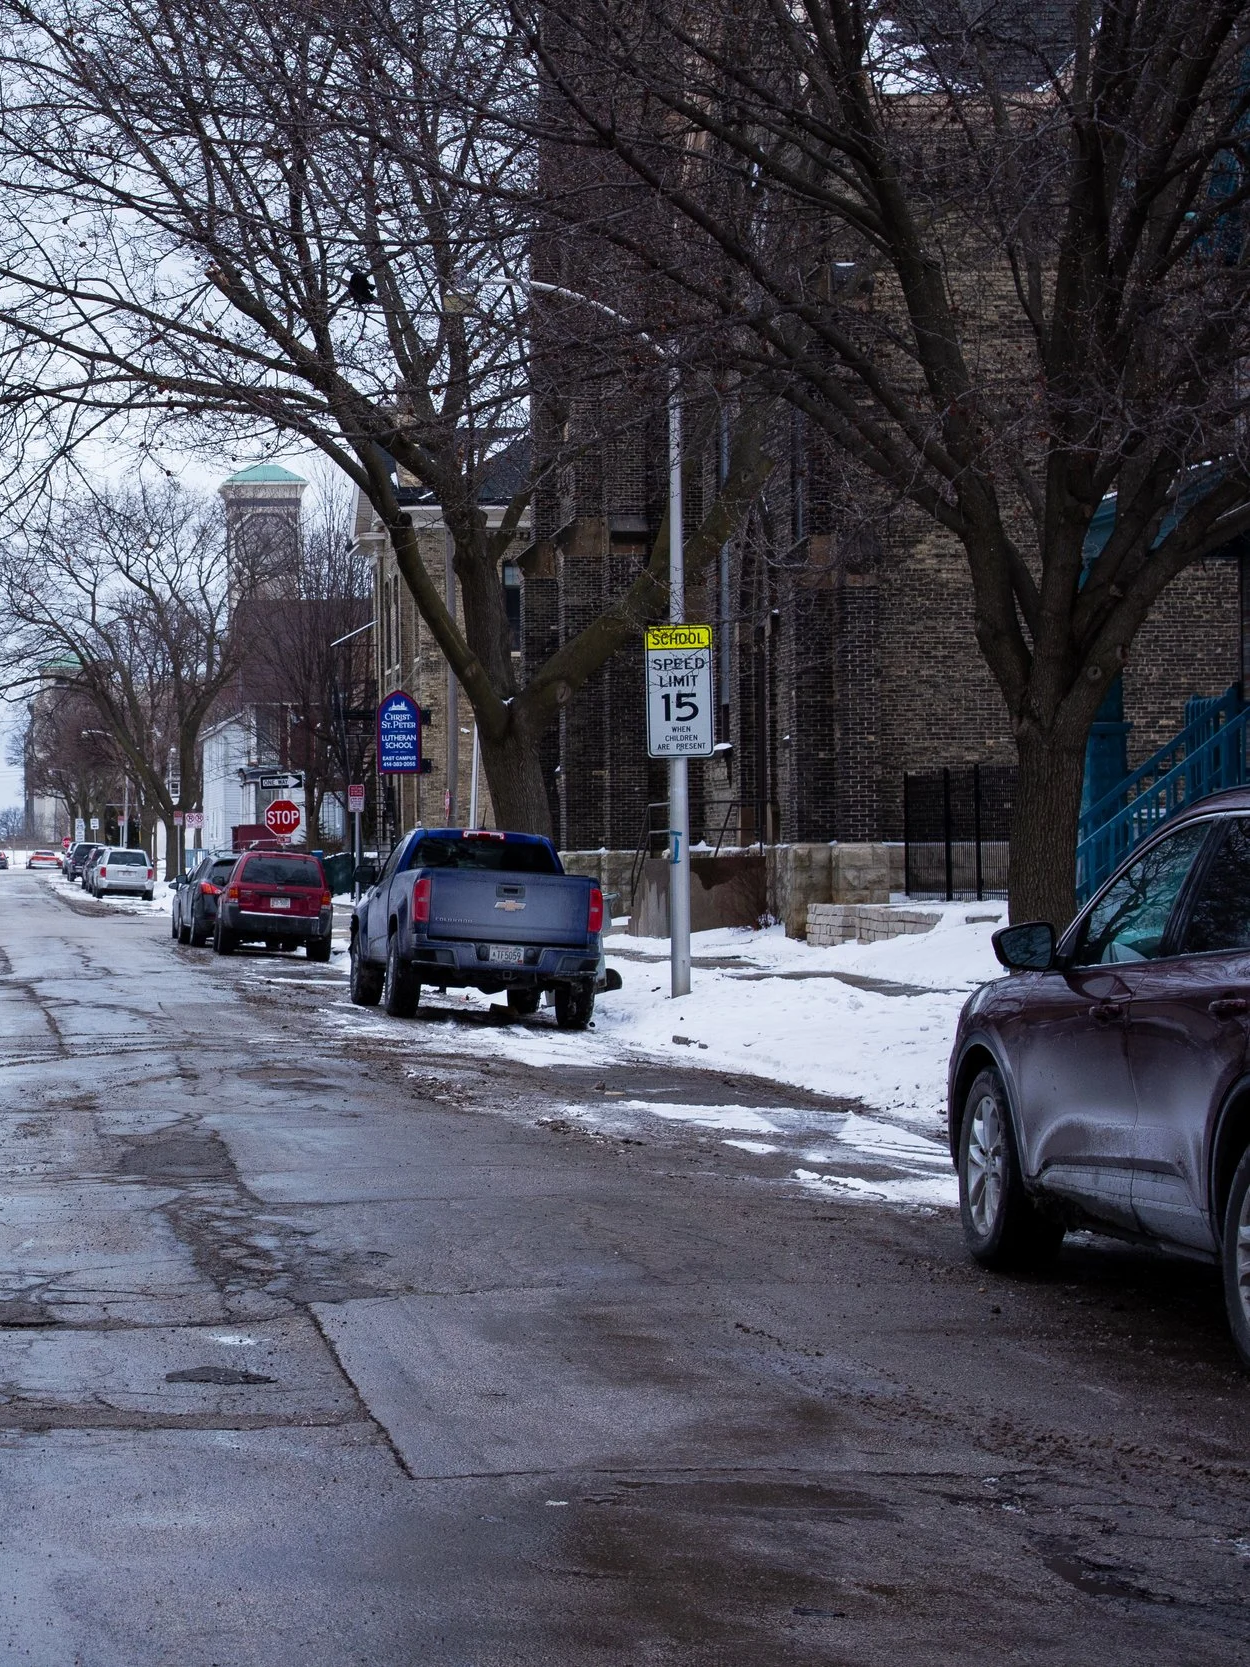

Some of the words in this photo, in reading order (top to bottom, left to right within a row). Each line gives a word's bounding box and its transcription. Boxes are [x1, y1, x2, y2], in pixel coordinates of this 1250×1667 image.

[652, 632, 705, 646] SCHOOL
[653, 658, 704, 670] SPEED
[659, 675, 698, 687] LIMIT
[661, 692, 699, 722] 15
[393, 721, 416, 729] PETER
[385, 741, 413, 749] SCHOOL
[657, 743, 670, 751] ARE
[676, 742, 706, 751] PRESENT
[267, 810, 299, 825] STOP
